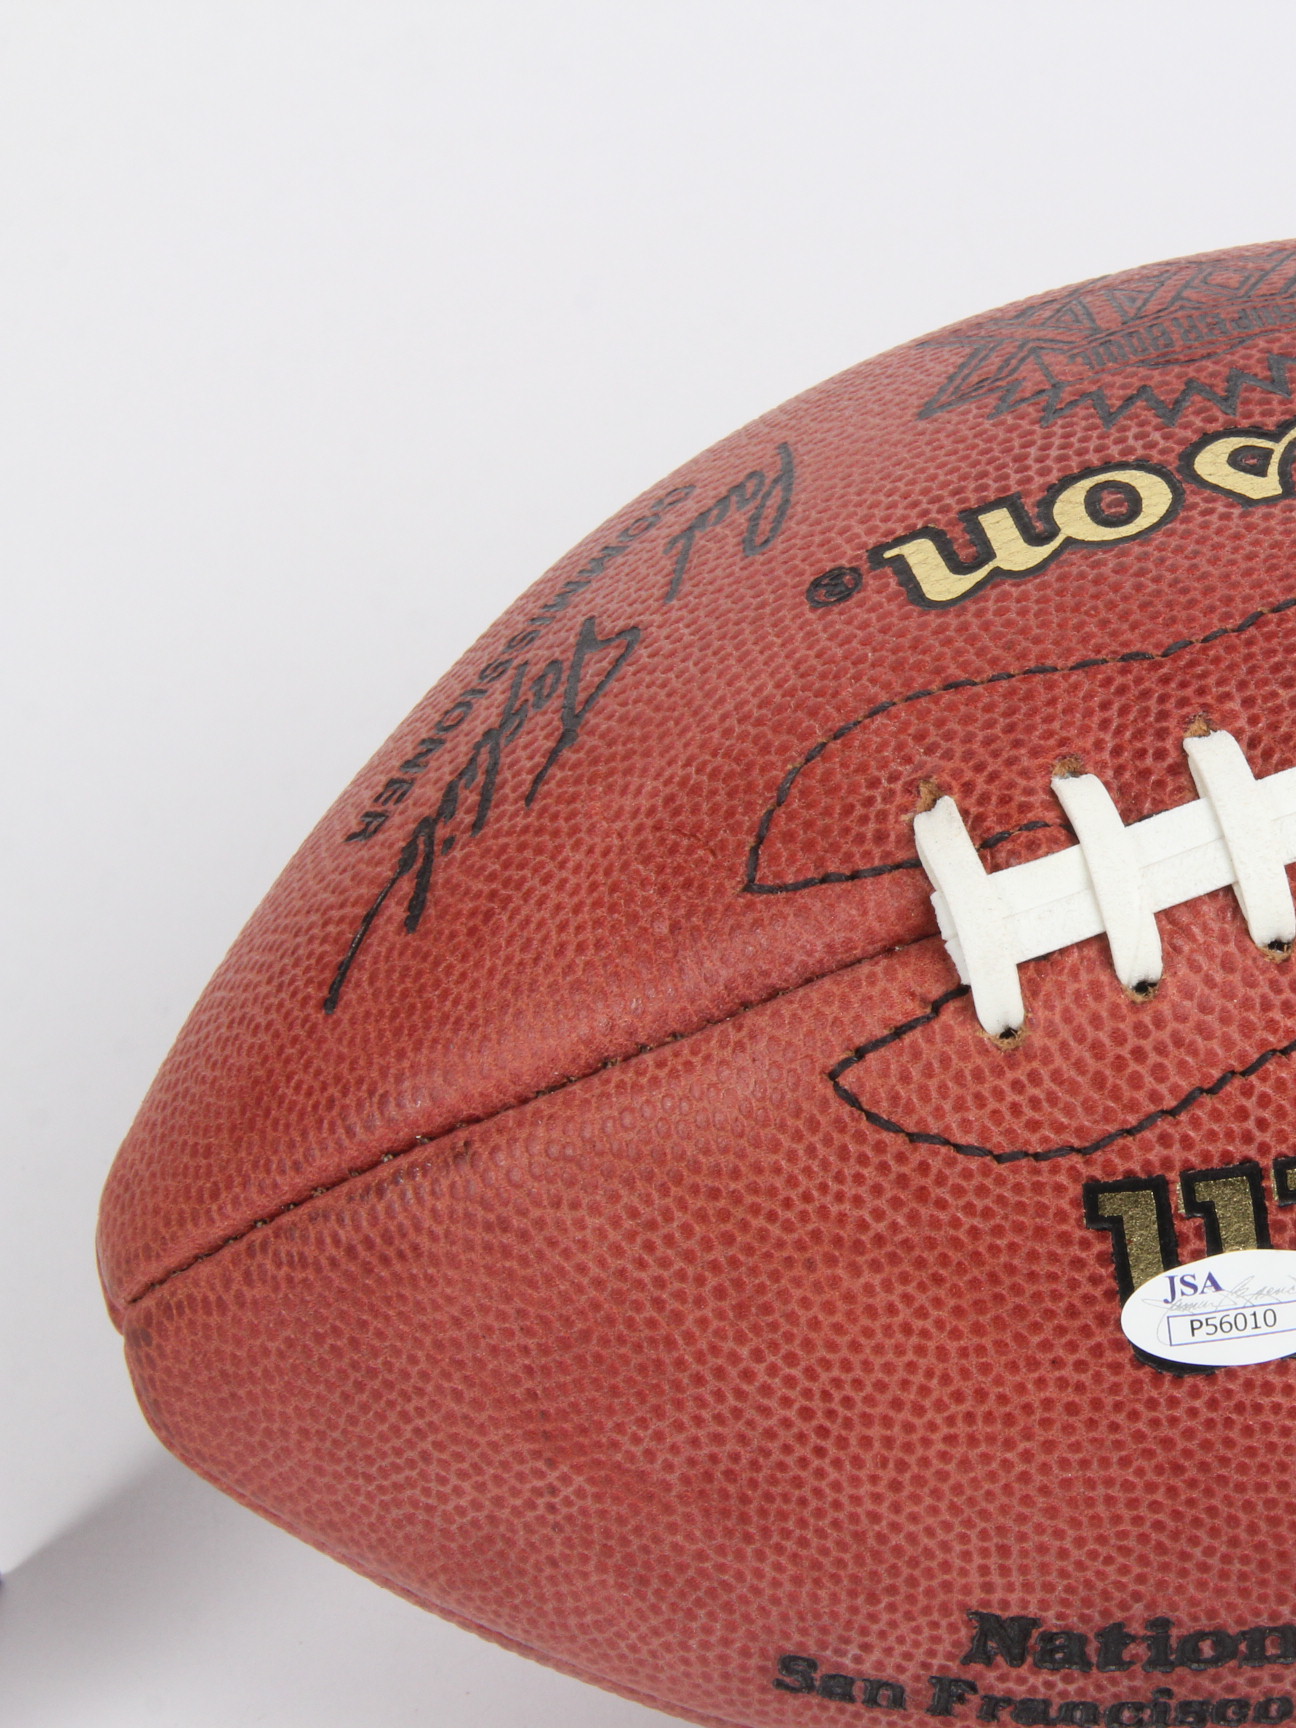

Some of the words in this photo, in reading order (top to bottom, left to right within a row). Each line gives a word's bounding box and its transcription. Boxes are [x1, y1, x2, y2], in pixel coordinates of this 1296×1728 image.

[343, 484, 696, 843] COMMISSIONER
[1163, 1271, 1224, 1304] JSA
[1189, 1308, 1278, 1338] P56010
[772, 1654, 908, 1715] San
[924, 1674, 1295, 1728] Francisco
